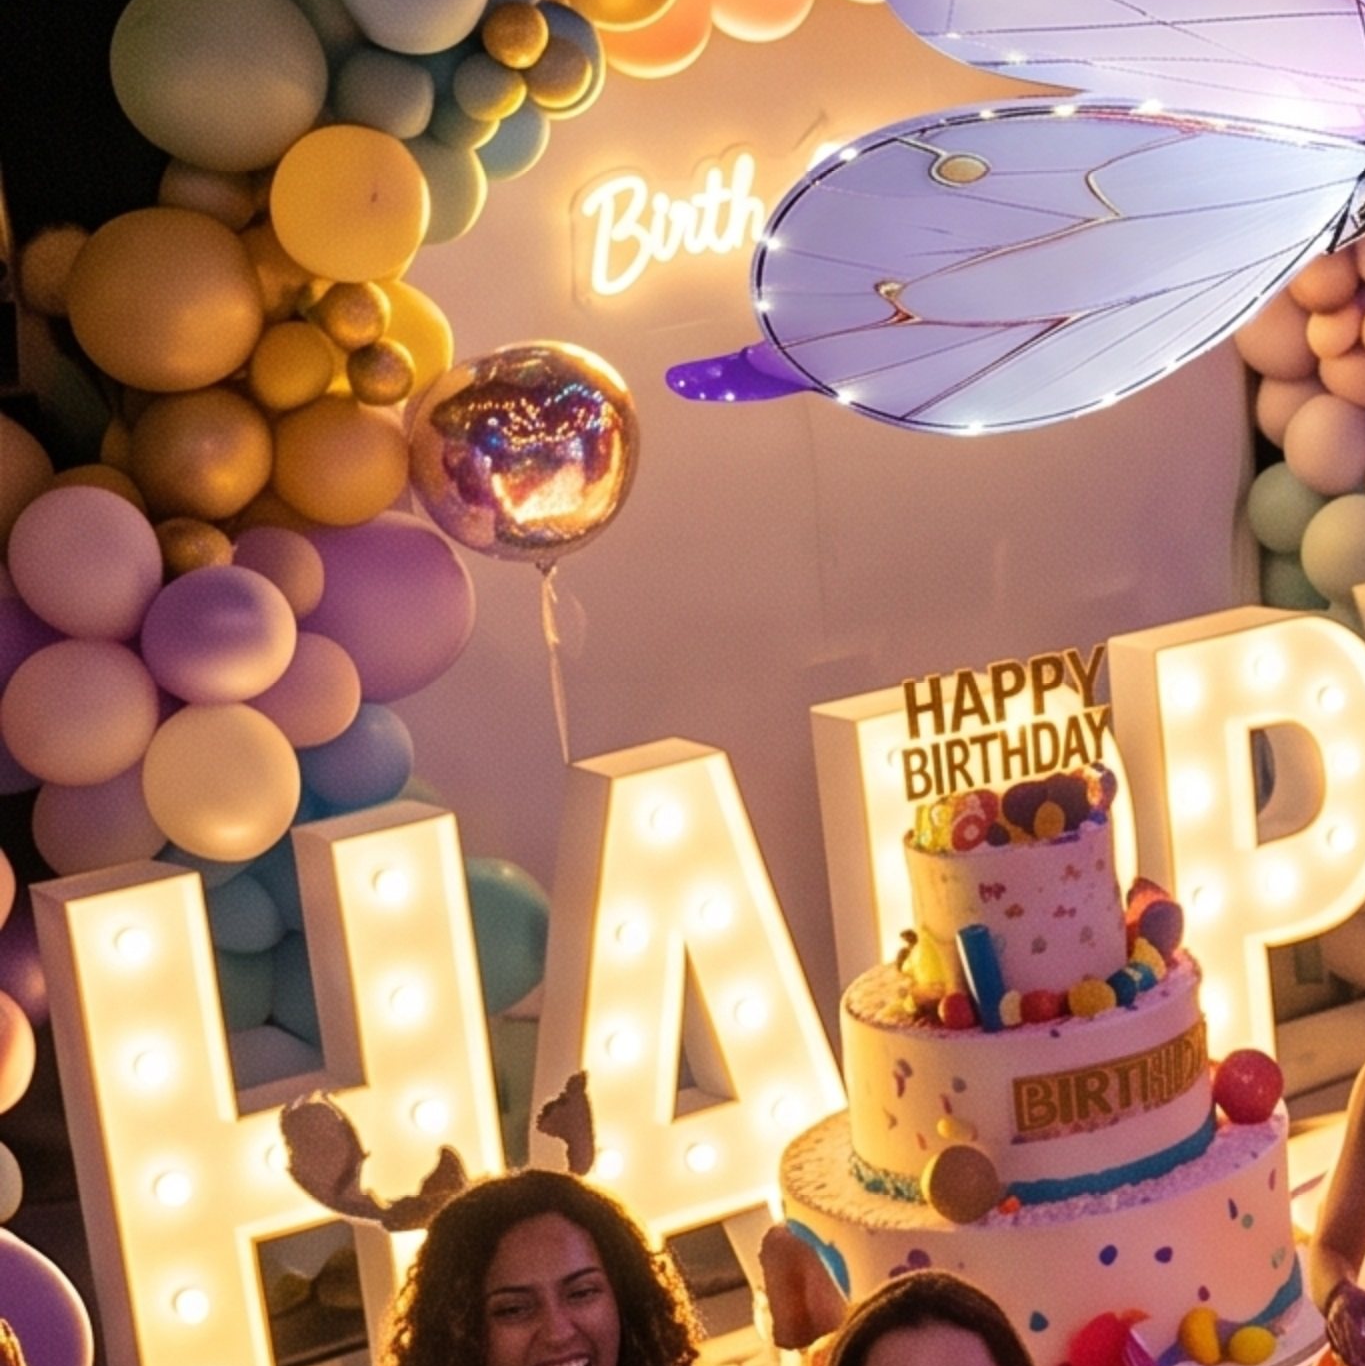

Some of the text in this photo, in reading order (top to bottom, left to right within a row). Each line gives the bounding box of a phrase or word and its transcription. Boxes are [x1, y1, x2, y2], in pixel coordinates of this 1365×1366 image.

[581, 143, 839, 296] Birth
[902, 642, 1106, 740] HAPPY
[901, 707, 1110, 802] BIRTHDAY
